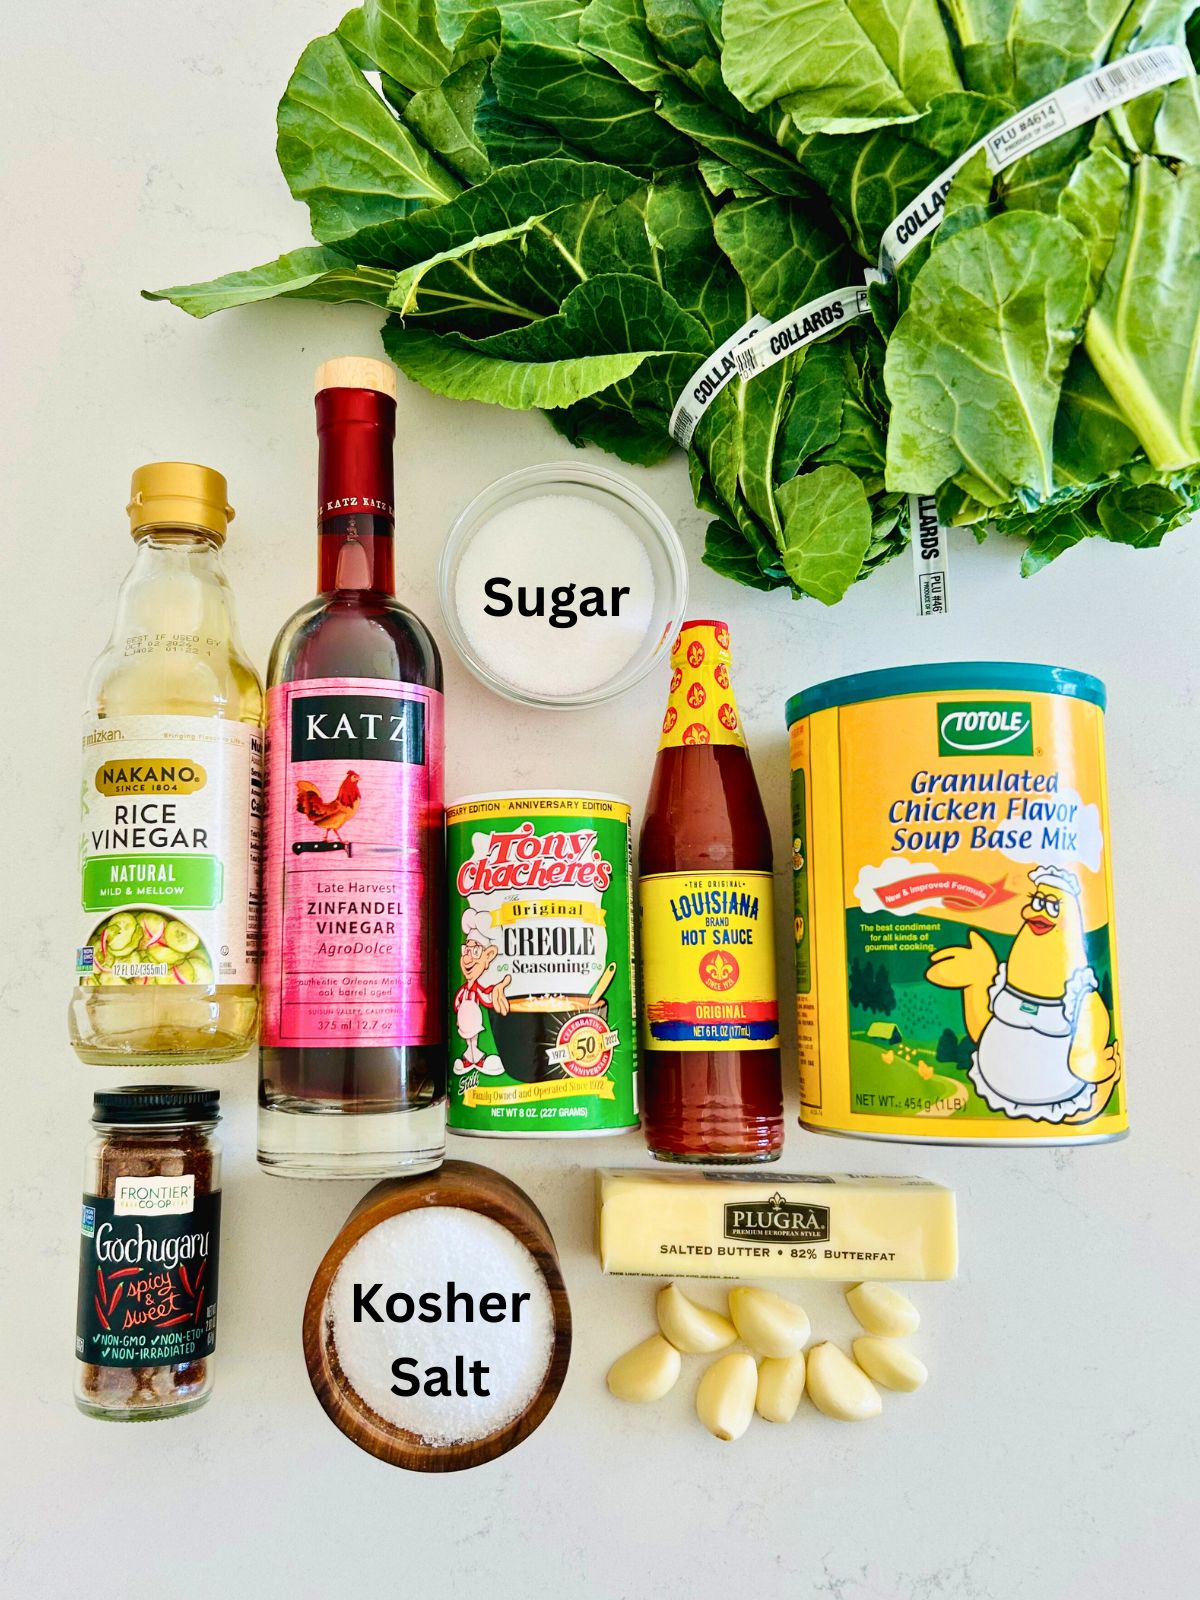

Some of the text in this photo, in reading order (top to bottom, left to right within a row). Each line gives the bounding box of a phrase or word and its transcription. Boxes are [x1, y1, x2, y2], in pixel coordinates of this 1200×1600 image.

[993, 105, 1056, 150] PLU #4614
[896, 174, 956, 245] COLLAR
[770, 301, 844, 355] COLLARDS
[694, 328, 759, 405] COLLA
[327, 497, 358, 511] KATZ
[363, 497, 387, 511] KATZ
[918, 495, 940, 560] LLARDS
[931, 575, 943, 613] PLU #46
[127, 635, 149, 645] BEST
[173, 634, 200, 643] USED
[306, 712, 407, 742] KATZ
[954, 711, 1023, 732] TOTOLE
[115, 784, 178, 792] SINCE 1804
[910, 769, 1059, 795] Granulated
[115, 804, 177, 825] RICE
[469, 803, 500, 814] EDITION
[508, 801, 579, 810] ANNIVERSARY
[582, 801, 613, 812] EDITION
[889, 797, 1078, 823] Chicken Flavor
[92, 828, 208, 850] VINEGAR
[488, 823, 598, 865] Tony
[891, 825, 1077, 853] Soup Base Mix
[110, 864, 176, 883] NATURAL
[100, 886, 184, 896] MILD & MELLOW
[317, 882, 396, 894] Late Harvest
[885, 881, 987, 903] New & Improved Formula
[307, 902, 404, 915] ZINFANDEL
[512, 904, 583, 917] Original
[670, 890, 759, 922] LOUISIANA
[316, 921, 395, 934] VINEGAR
[705, 917, 729, 927] BRAND
[860, 923, 941, 932] The best condiment
[504, 927, 596, 957] CREOLE
[681, 929, 753, 946] HOT SAUCE
[870, 933, 929, 942] for all kinds of
[318, 942, 393, 957] AgroDolce
[864, 943, 898, 953] gourmet
[113, 964, 121, 976] 12
[122, 964, 129, 976] FL
[512, 959, 591, 974] Seasoning
[318, 988, 392, 998] oak barrel aged
[695, 1005, 747, 1019] ORIGINAL
[318, 1020, 393, 1031] 375 ml 12.7 oz
[563, 1018, 603, 1041] CELEBRATING
[693, 1025, 705, 1037] NET
[706, 1025, 711, 1037] 6
[712, 1025, 719, 1037] FL
[720, 1025, 728, 1037] OZ
[551, 1049, 566, 1060] 1972
[576, 1036, 596, 1061] 50
[569, 1054, 609, 1076] ANNIVERSARY
[458, 1072, 480, 1096] Still
[472, 1089, 492, 1103] Family
[493, 1088, 517, 1101] Owned
[518, 1087, 532, 1098] and
[533, 1083, 568, 1098] Operated
[589, 1081, 605, 1091] 1972
[856, 1094, 876, 1106] NET
[904, 1097, 922, 1110] 454
[924, 1100, 931, 1112] g
[491, 1108, 504, 1117] NET
[506, 1108, 517, 1117] WT
[519, 1108, 524, 1117] 8
[540, 1107, 557, 1118] (227
[558, 1107, 588, 1118] GRAMS)
[121, 1186, 189, 1200] FRONTIER
[138, 1200, 171, 1209] CO-OP
[732, 1209, 820, 1230] PLUGRÀ
[764, 1229, 799, 1237] EUROPEAN
[95, 1222, 209, 1270] Gochugaru
[659, 1244, 896, 1262] SALTED BUTTER 82% BUTTERFAT
[126, 1271, 176, 1302] spicy
[145, 1294, 154, 1305] &
[122, 1293, 183, 1330] sweet
[101, 1334, 147, 1347] NON-GMO
[111, 1342, 196, 1360] NON-IRRADIATED
